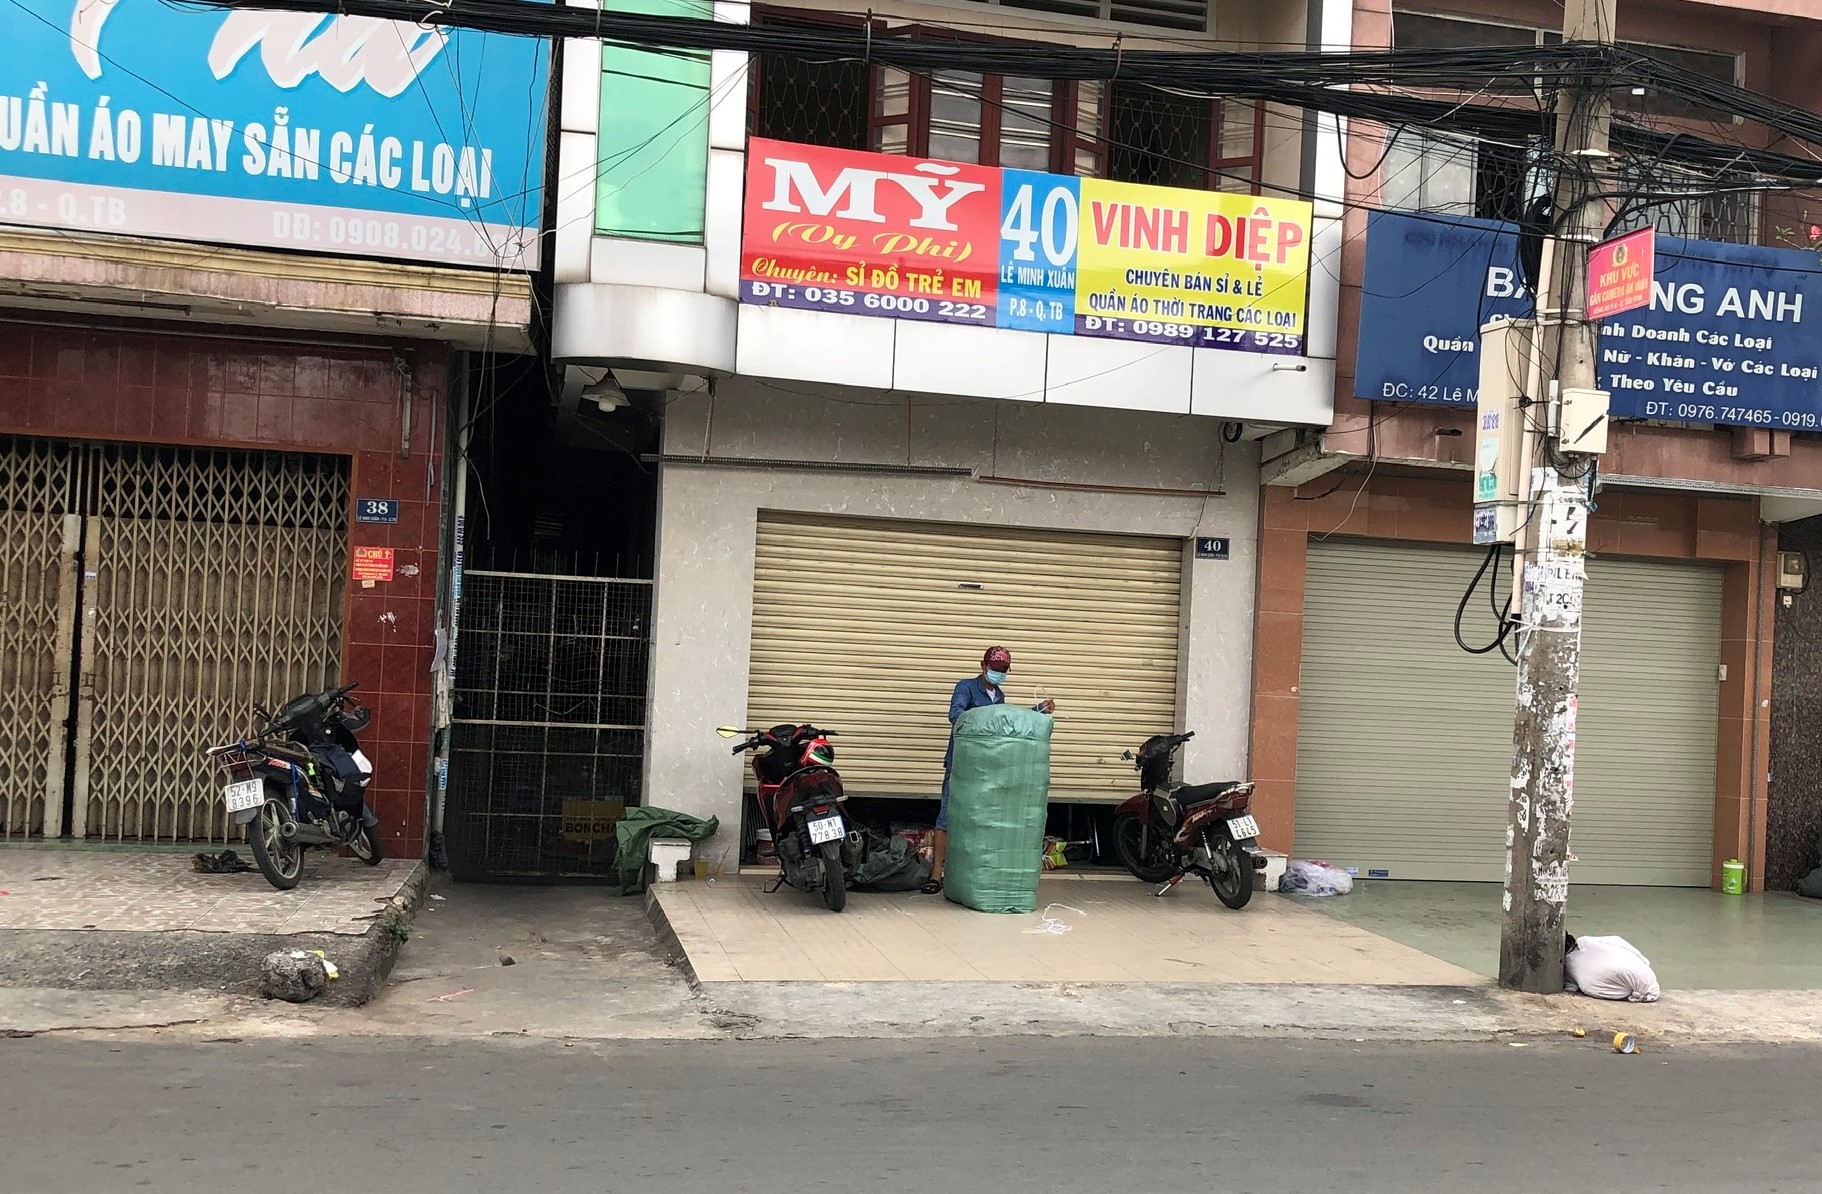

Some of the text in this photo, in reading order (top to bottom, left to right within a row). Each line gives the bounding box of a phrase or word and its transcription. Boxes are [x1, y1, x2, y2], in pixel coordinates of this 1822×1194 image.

[88, 96, 141, 163] ÁO
[152, 113, 234, 171] MAY
[243, 106, 320, 180] SẴN
[330, 123, 402, 188] CÁC
[411, 141, 492, 207] LOẠI
[761, 157, 986, 231] MỸ
[273, 211, 320, 241] DĐ:
[1000, 184, 1078, 266] 40
[1092, 201, 1303, 271] VINH DIỆP
[751, 257, 981, 298] Chuyên: SỈ ĐỒ TRẺ EM
[1001, 261, 1075, 290] LÊ MINH XUÂN
[1125, 269, 1263, 296] CHUYÊN BÁN SỈ & LẺ
[1600, 263, 1639, 287] KHU VỰC
[752, 281, 986, 319] ĐT: 035 6000 222
[1009, 297, 1027, 317] P.8
[1050, 303, 1063, 320] TB
[1089, 289, 1296, 329] QUẦN ÁO THỜI TRANG CÁC LOẠI
[1716, 287, 1803, 323] ANH
[1085, 315, 1298, 348] ĐT: 0989 127 525
[1631, 325, 1690, 342] Doanh
[1696, 331, 1729, 345] Các
[1734, 334, 1772, 352] Loại
[1423, 335, 1474, 353] Quần
[1604, 349, 1631, 364] Nữ
[1647, 353, 1695, 369] Khăn
[1711, 357, 1736, 372] Vớ
[1741, 360, 1774, 375] Các
[1781, 364, 1818, 381] Loại
[1382, 383, 1413, 398] ĐC:
[1418, 385, 1438, 400] 42
[1443, 387, 1462, 401] Lê
[1646, 402, 1672, 416] ĐT:
[1611, 374, 1738, 397] Theo Yêu Cầu
[367, 501, 388, 514] 38
[1204, 540, 1221, 551] 40
[232, 794, 258, 809] 8396
